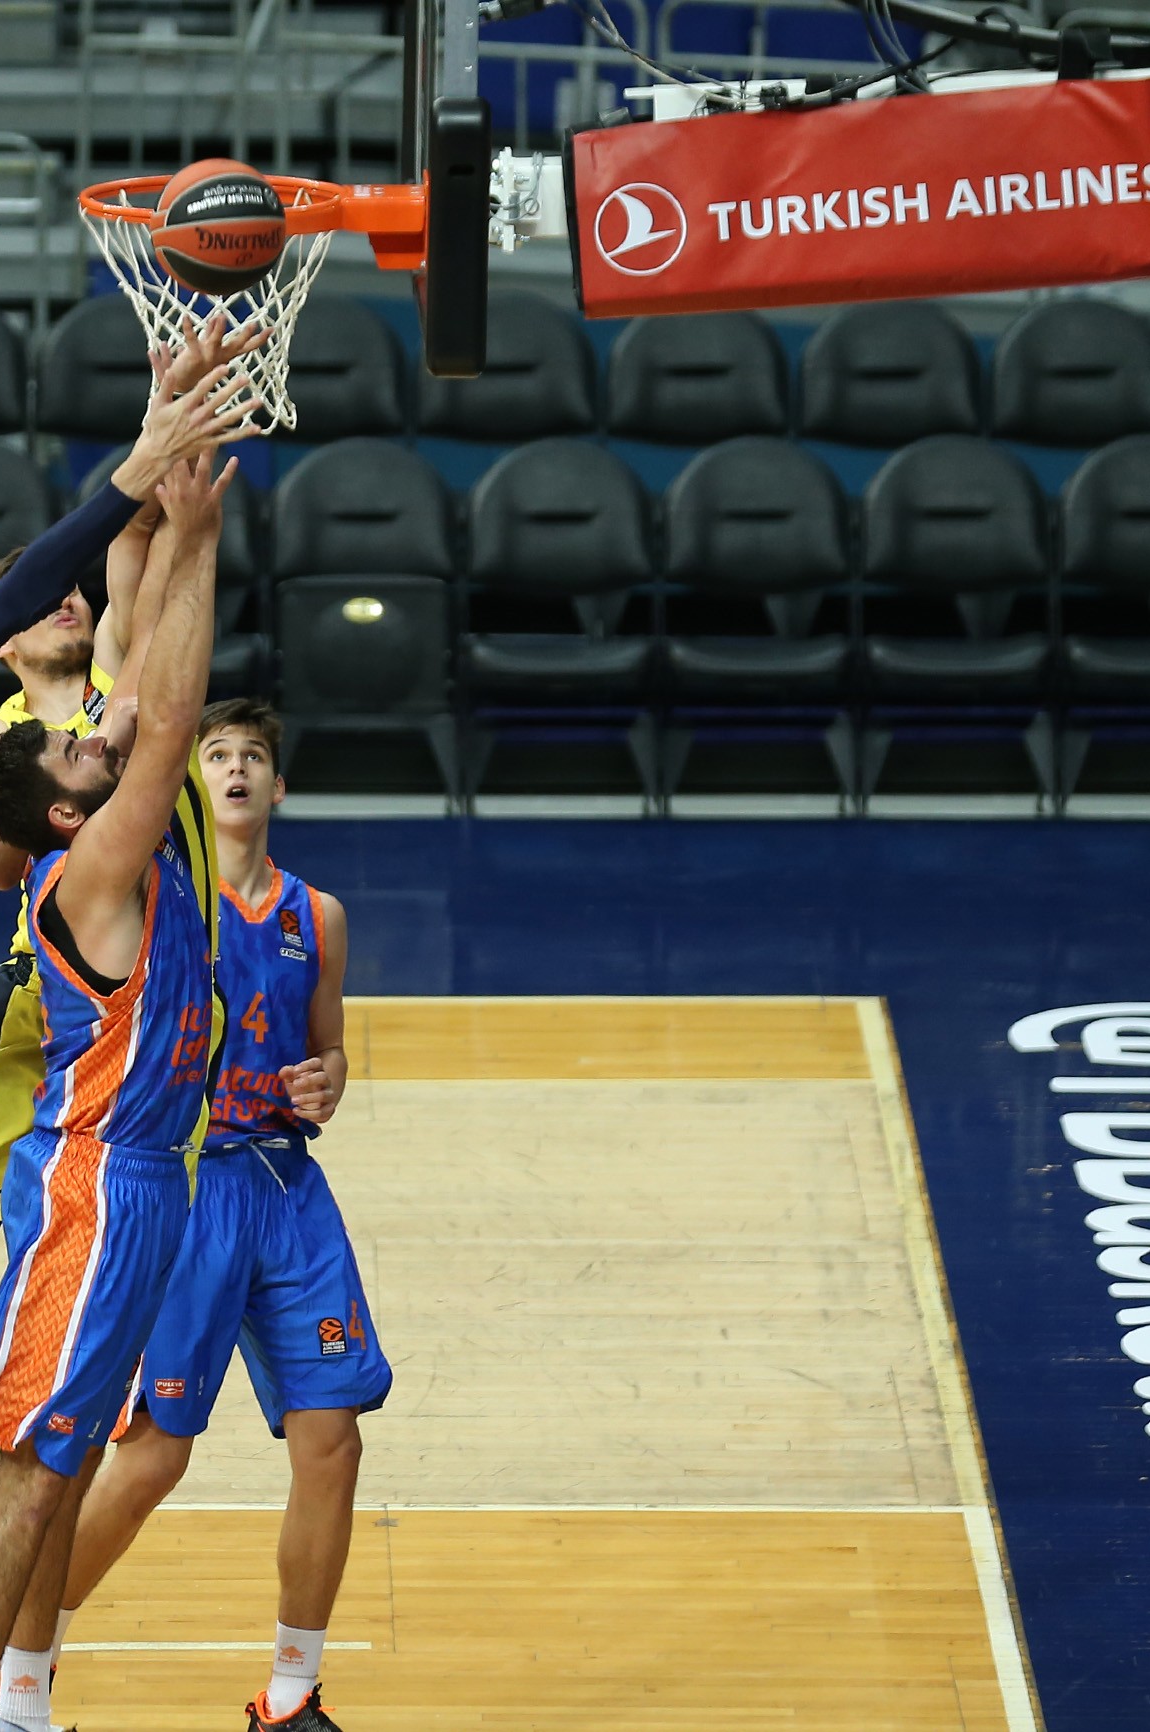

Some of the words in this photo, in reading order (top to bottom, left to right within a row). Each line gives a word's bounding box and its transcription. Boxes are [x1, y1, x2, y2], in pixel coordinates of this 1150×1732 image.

[196, 226, 281, 250] SPALDING
[707, 182, 930, 242] TURKISH
[241, 990, 269, 1043] 4
[348, 1299, 366, 1350] 4
